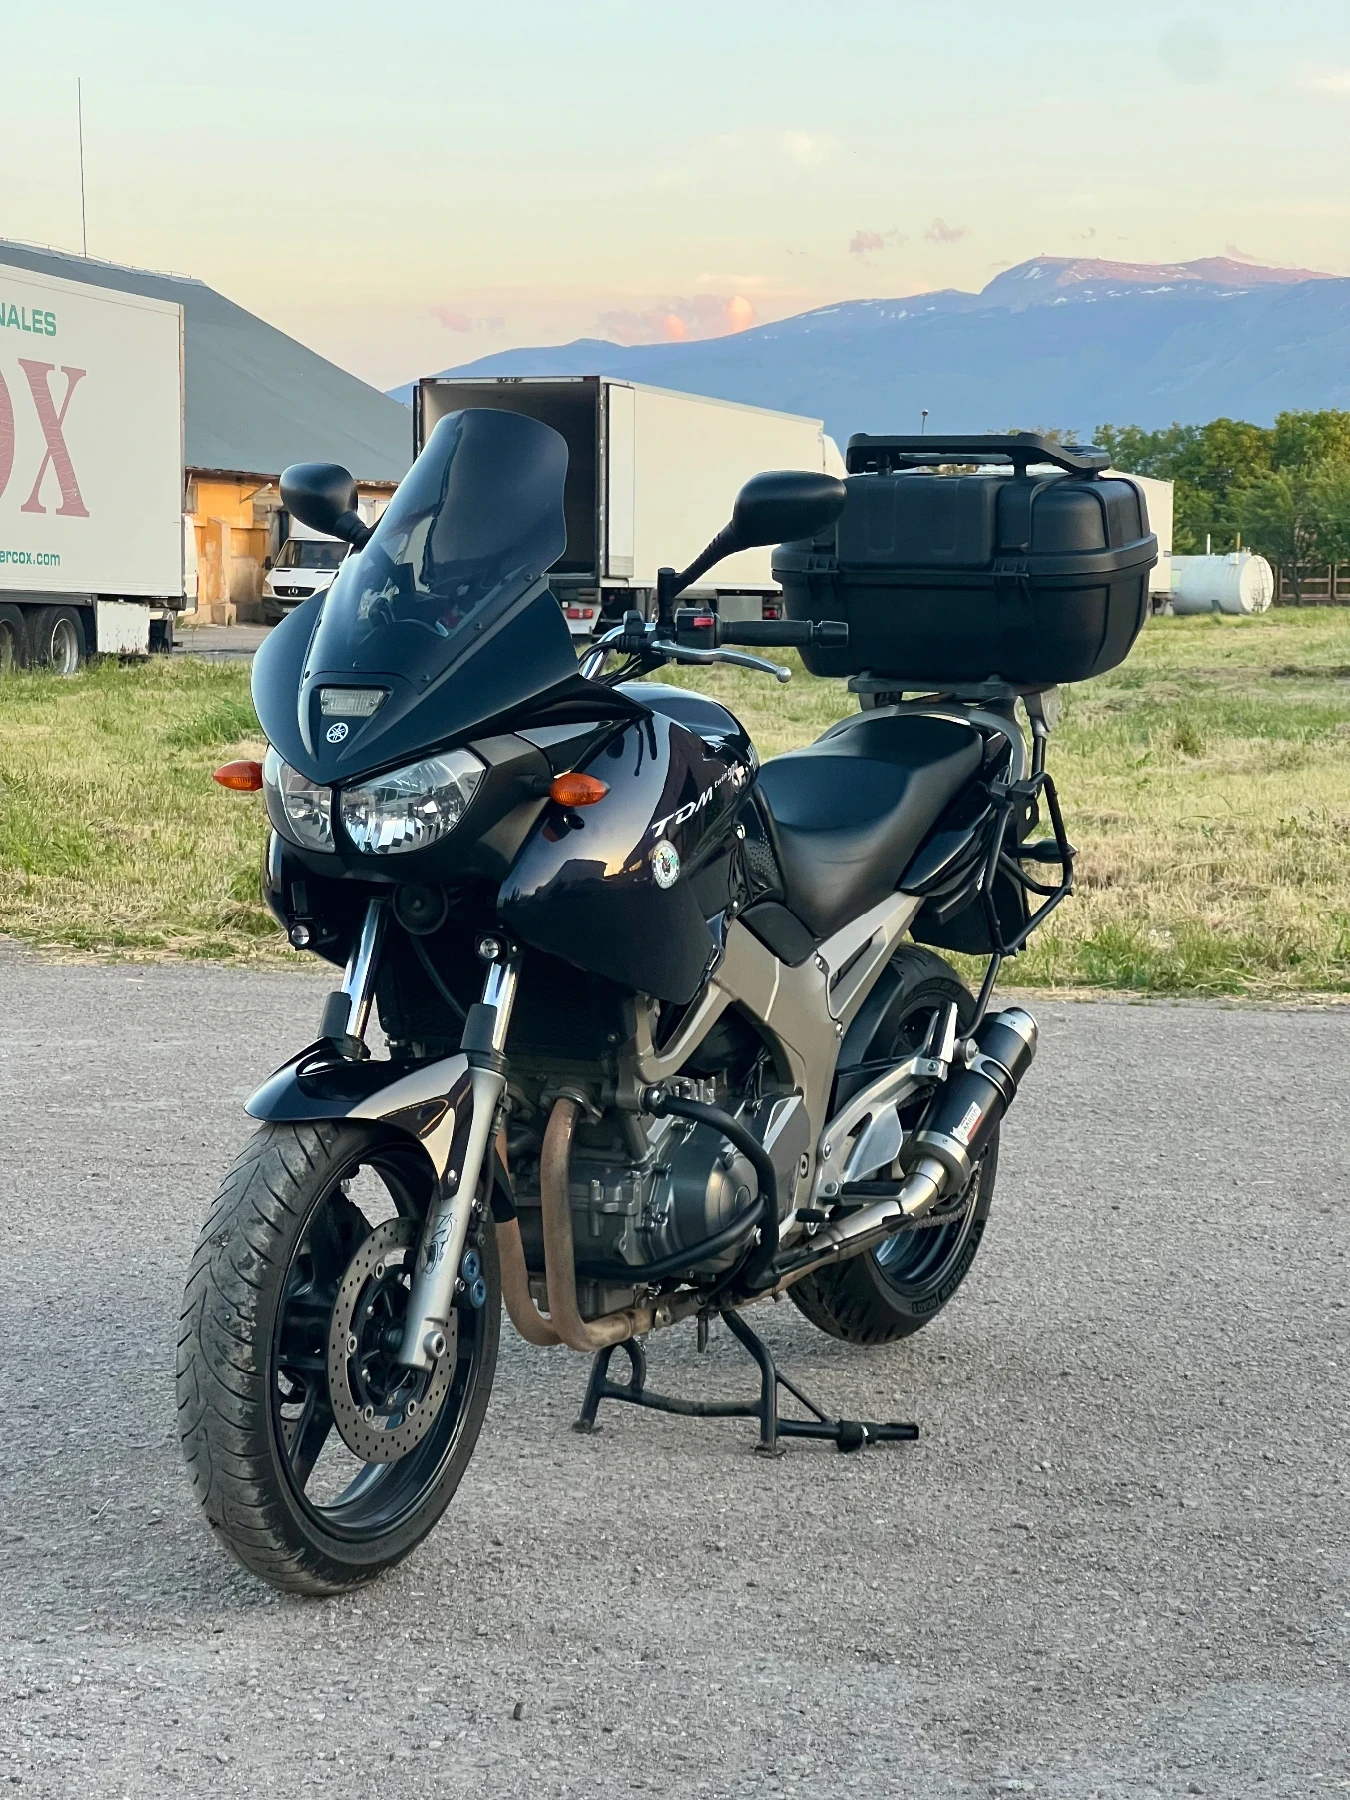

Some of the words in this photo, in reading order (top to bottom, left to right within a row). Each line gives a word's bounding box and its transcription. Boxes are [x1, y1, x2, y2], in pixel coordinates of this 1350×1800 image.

[0, 358, 90, 518] X
[651, 786, 713, 838] TDM
[940, 1241, 976, 1300] MICHELIN
